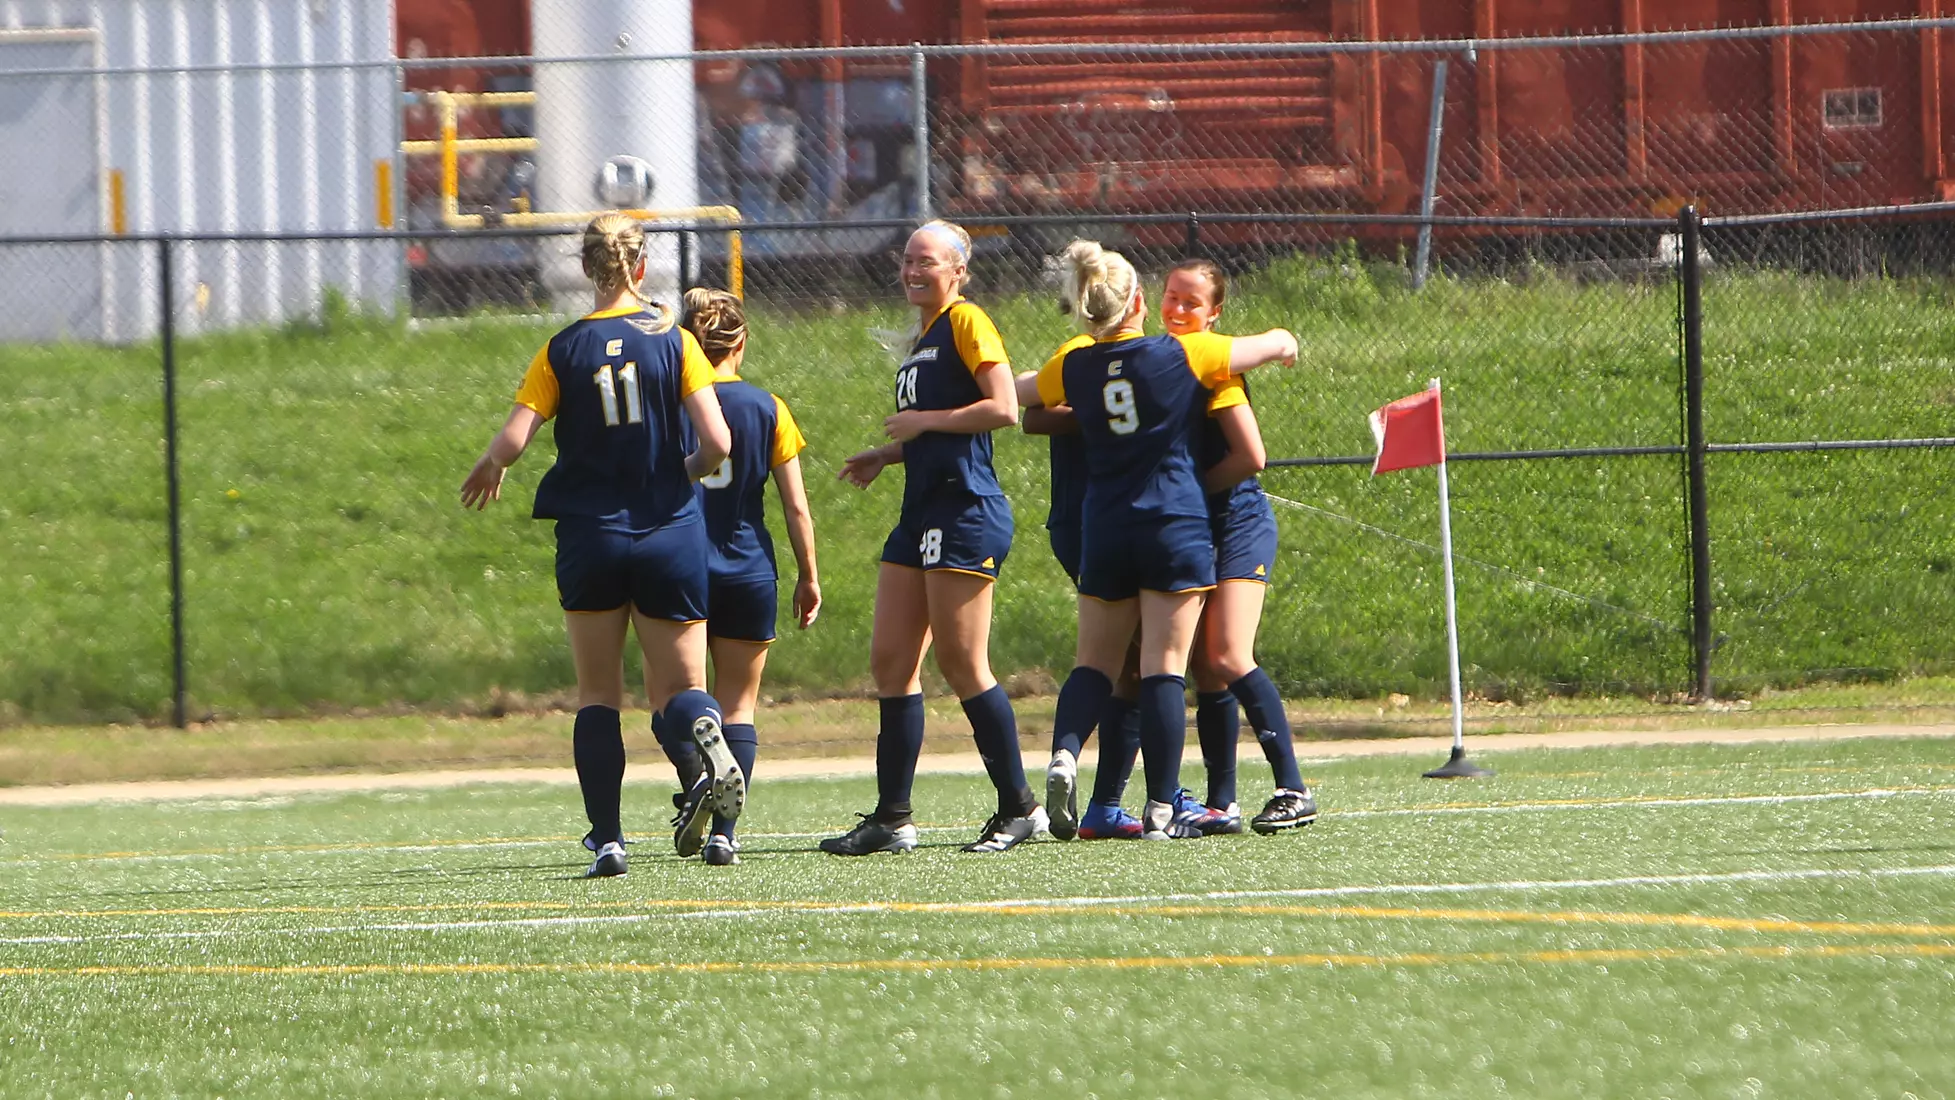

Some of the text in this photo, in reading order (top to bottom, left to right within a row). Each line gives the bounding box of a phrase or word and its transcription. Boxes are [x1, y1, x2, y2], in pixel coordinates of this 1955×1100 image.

[593, 361, 643, 427] 11
[897, 366, 918, 409] 28
[1103, 379, 1140, 435] 9
